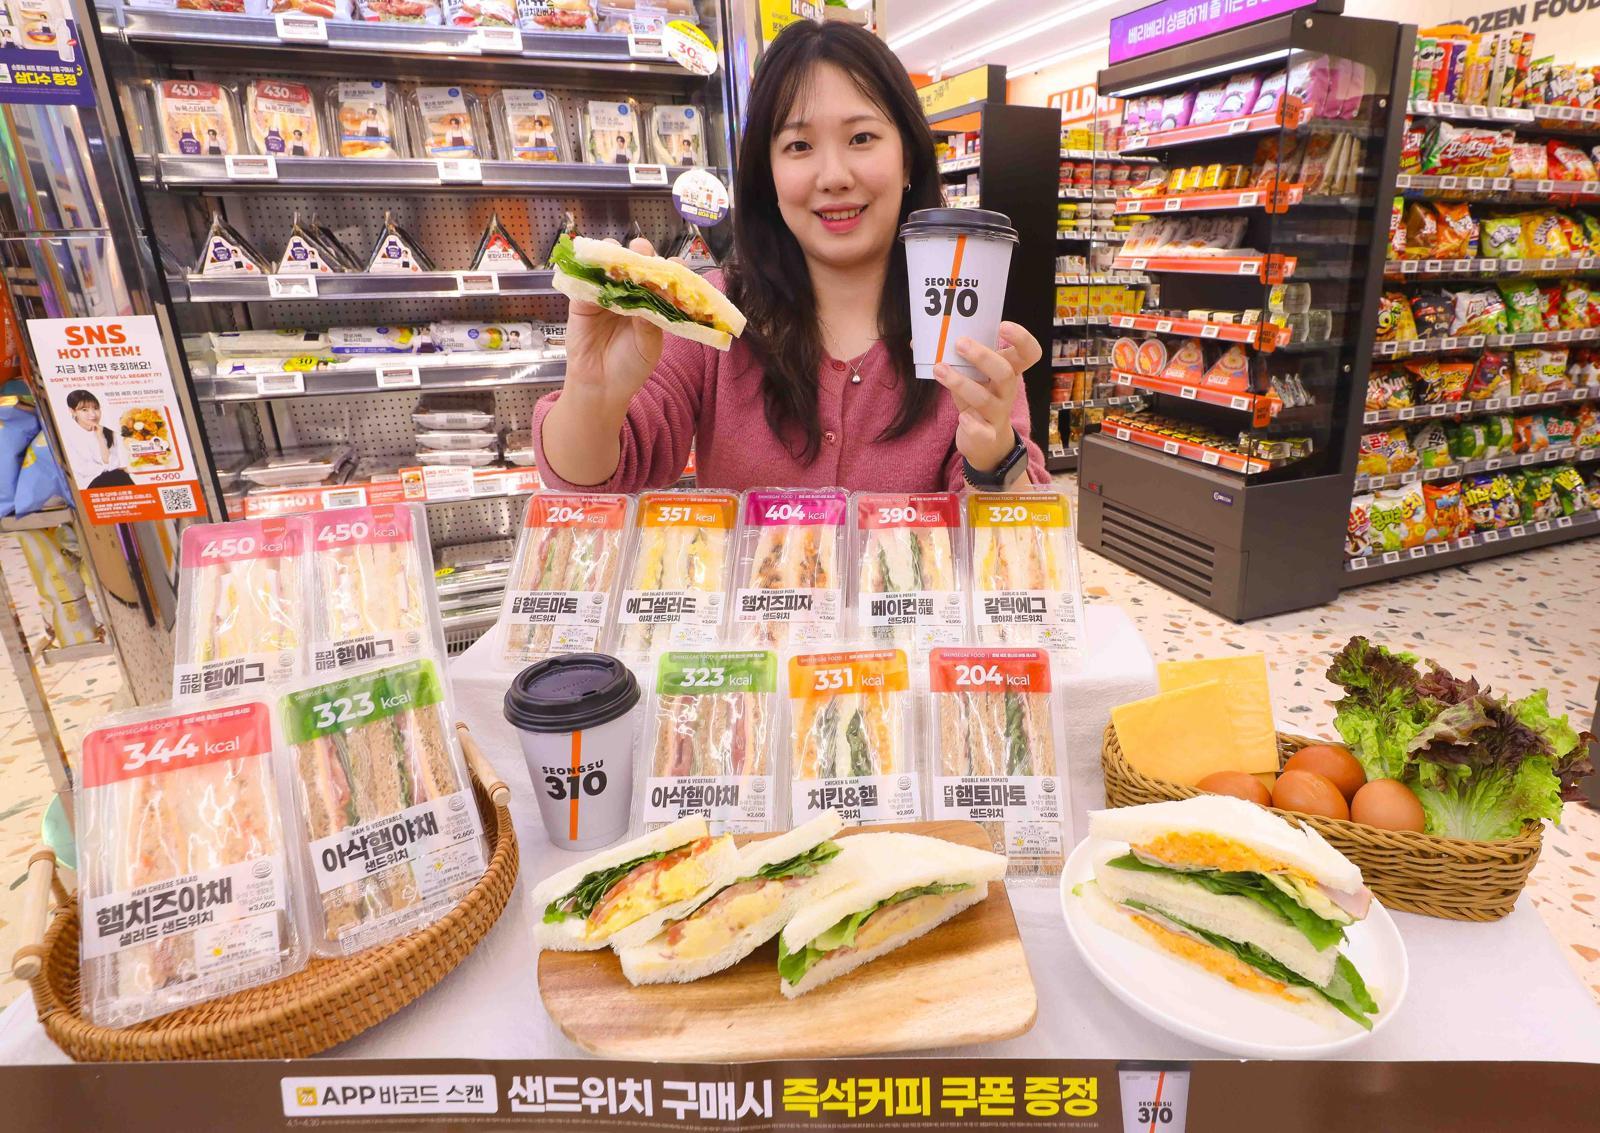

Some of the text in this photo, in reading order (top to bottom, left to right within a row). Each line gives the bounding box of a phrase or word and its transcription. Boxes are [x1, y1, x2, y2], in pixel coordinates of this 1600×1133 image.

[1128, 4, 1208, 44] 베리베리 상큼하게
[1437, 4, 1526, 34] OZEN
[14, 72, 77, 86] 삼다수 증정
[172, 84, 198, 97] 430
[264, 86, 289, 98] 430
[924, 278, 979, 288] SEONGSU
[924, 288, 979, 318] 310
[64, 324, 127, 346] SNS
[57, 346, 142, 359] HOT ITEM!
[56, 361, 151, 374] 지금 놓치면 후회해요!
[284, 495, 316, 507] HOT
[546, 507, 607, 523] 204 kcal
[656, 507, 716, 523] 351 kcal
[765, 504, 828, 521] 404 kcal
[878, 507, 940, 523] 390 kcal
[989, 506, 1051, 522] 320 kcal
[317, 522, 398, 543] 450 kcal
[201, 537, 287, 558] 450 kcal
[522, 597, 578, 614] 햄토마토
[626, 598, 696, 614] 에그샐러드
[742, 594, 813, 612] 햄치즈피자
[871, 599, 917, 616] 베이컨
[984, 598, 1047, 614] 갈릭에그
[653, 614, 681, 622] 샌드위치
[762, 612, 790, 620] 샌드위치
[887, 616, 916, 624] 샌드위치
[1014, 615, 1042, 623] 샌드위치
[315, 650, 335, 661] 프리
[336, 640, 393, 666] 햄에그
[316, 660, 336, 671] 미엄
[180, 672, 201, 684] 프리
[204, 663, 265, 691] 햄에그
[680, 668, 752, 687] 323 kcal
[814, 668, 884, 691] 331 kcal
[955, 665, 1030, 686] 204 kcal
[180, 683, 201, 694] 미엄
[313, 690, 411, 729] 323 kcal
[122, 733, 240, 771] 344 kcal
[542, 760, 604, 775] SEONGSU
[545, 770, 607, 800] 310
[652, 785, 739, 808] 아삭햄야채
[808, 784, 878, 810] 치킨&햄
[955, 784, 1027, 806] 햄토마토
[372, 814, 403, 830] VEGETABLE
[969, 809, 1004, 818] 샌드위치
[322, 811, 439, 872] 아삭햄야채
[365, 848, 409, 873] 샌드위치
[131, 875, 198, 897] HAM CHEESE SALAD
[96, 876, 232, 938] 햄치즈야채
[248, 900, 276, 912] ₩3,000
[120, 910, 214, 947] 샐러드 샌드위치
[322, 1084, 484, 1105] APP 바코드 스캔
[508, 1076, 1098, 1120] 샌드위치 구매시 즉석커피 쿠폰 증정
[1138, 1107, 1173, 1124] 310
